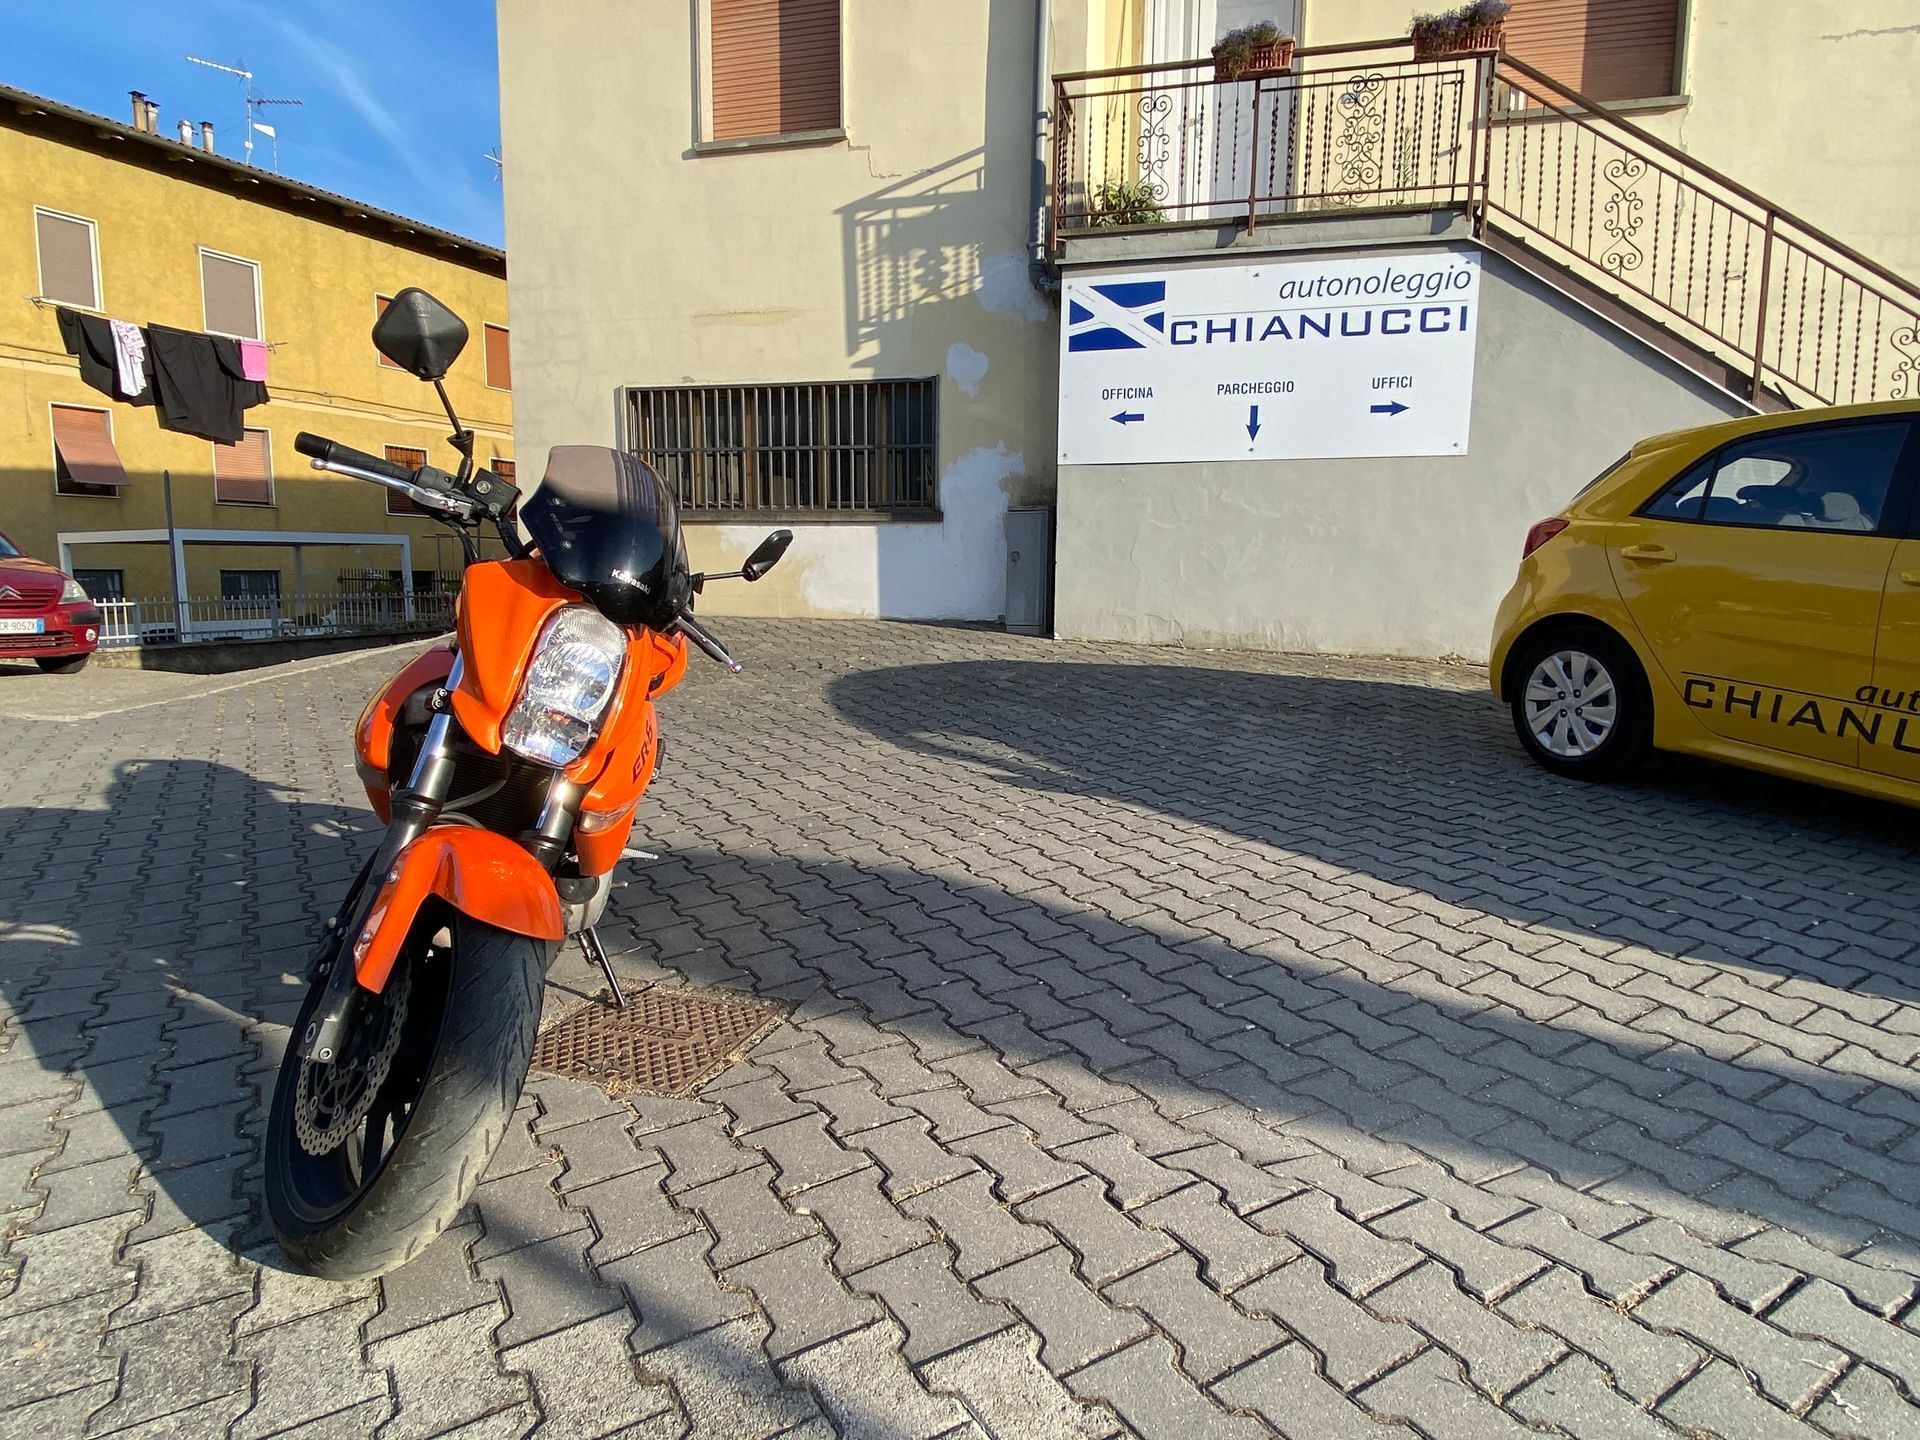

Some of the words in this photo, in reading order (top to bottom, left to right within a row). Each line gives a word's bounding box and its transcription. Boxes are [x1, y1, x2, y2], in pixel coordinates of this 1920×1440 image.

[1279, 265, 1471, 299] autonoleggio
[1170, 305, 1468, 345] CHIANUCCI
[1216, 380, 1295, 396] PARCHEGGIO
[1371, 376, 1413, 390] UFFICI
[1101, 386, 1154, 401] OFFICINA
